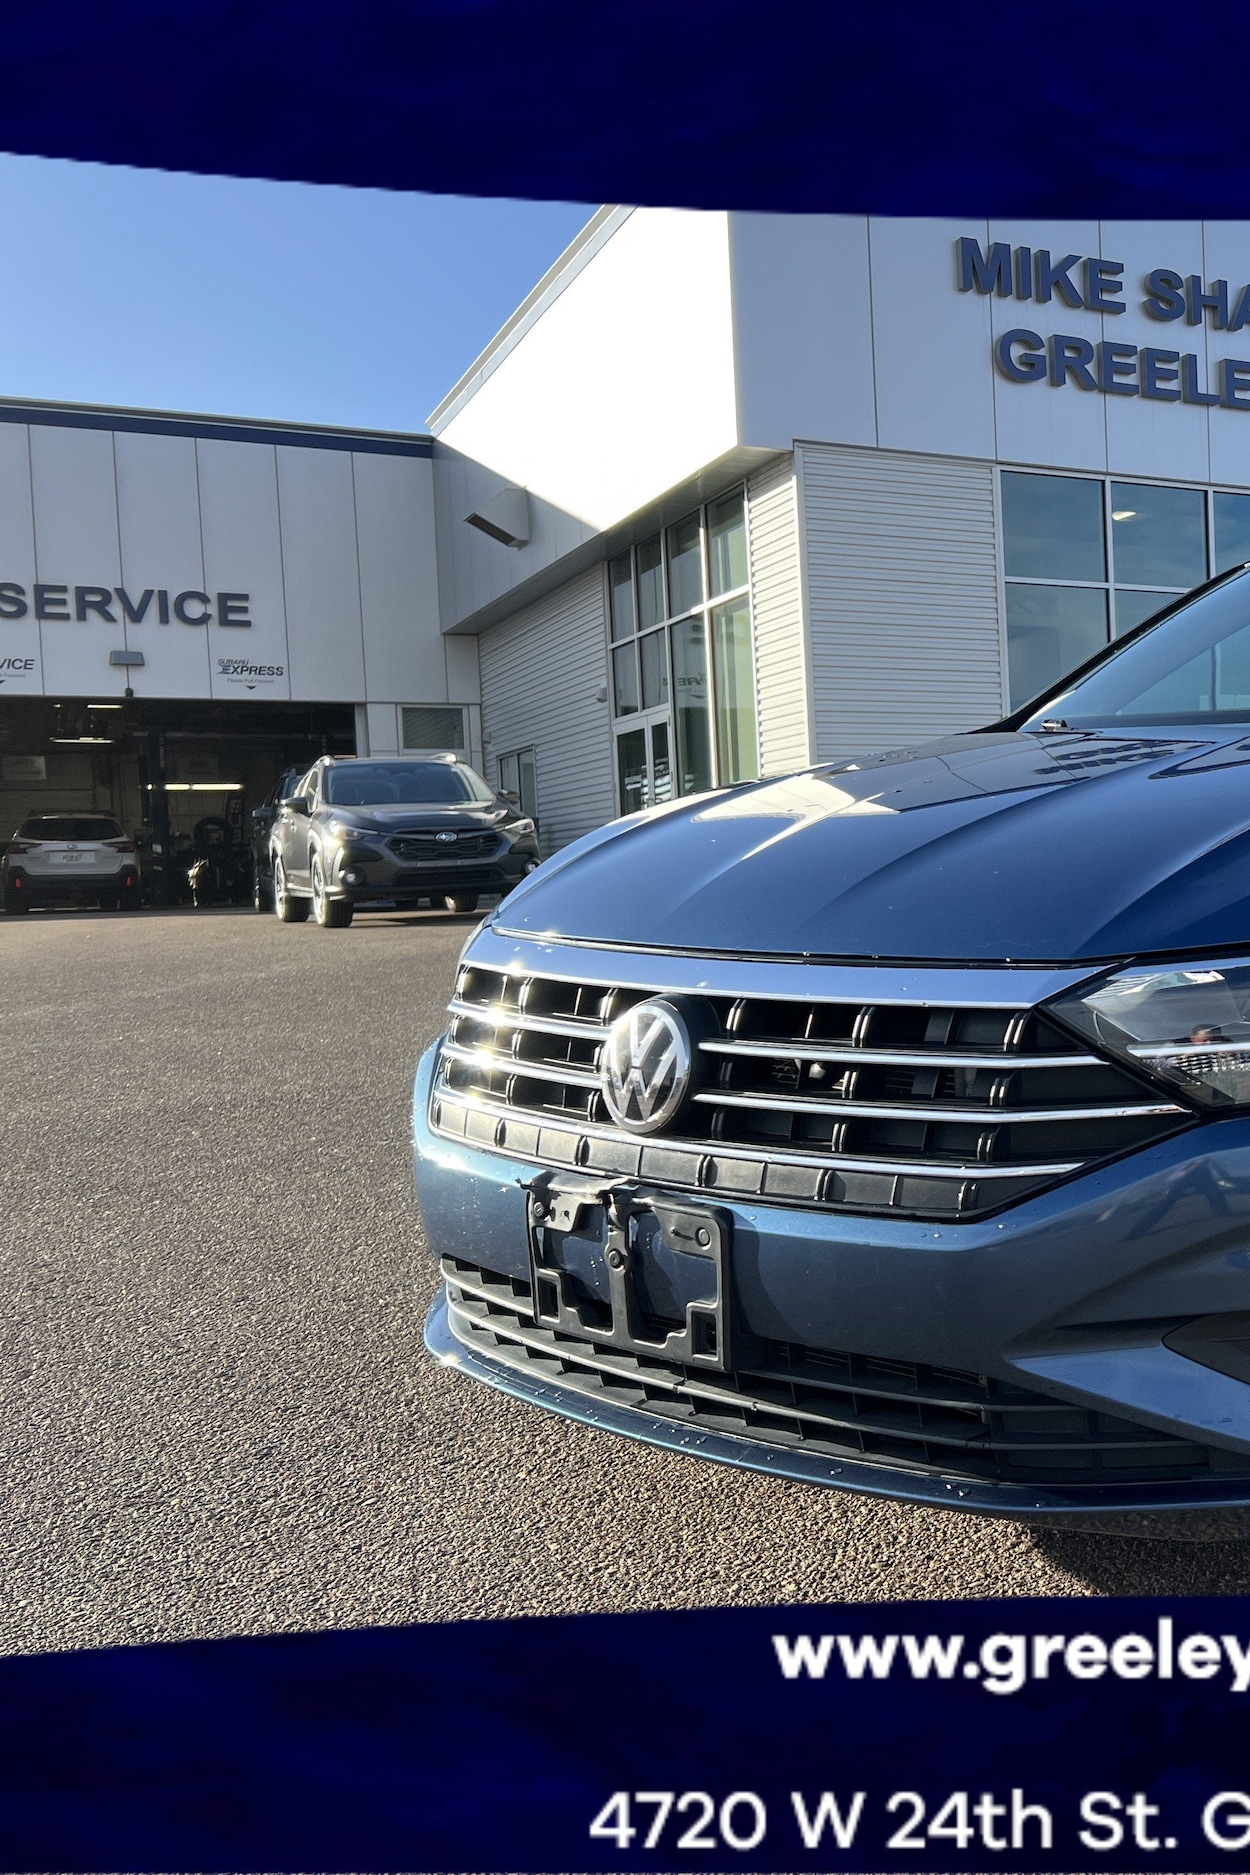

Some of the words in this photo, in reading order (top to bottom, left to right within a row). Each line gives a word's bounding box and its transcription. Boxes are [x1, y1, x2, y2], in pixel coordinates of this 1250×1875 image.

[956, 237, 1127, 315] MIKE
[0, 582, 252, 628] SERVICE
[217, 665, 284, 676] EXPRESS
